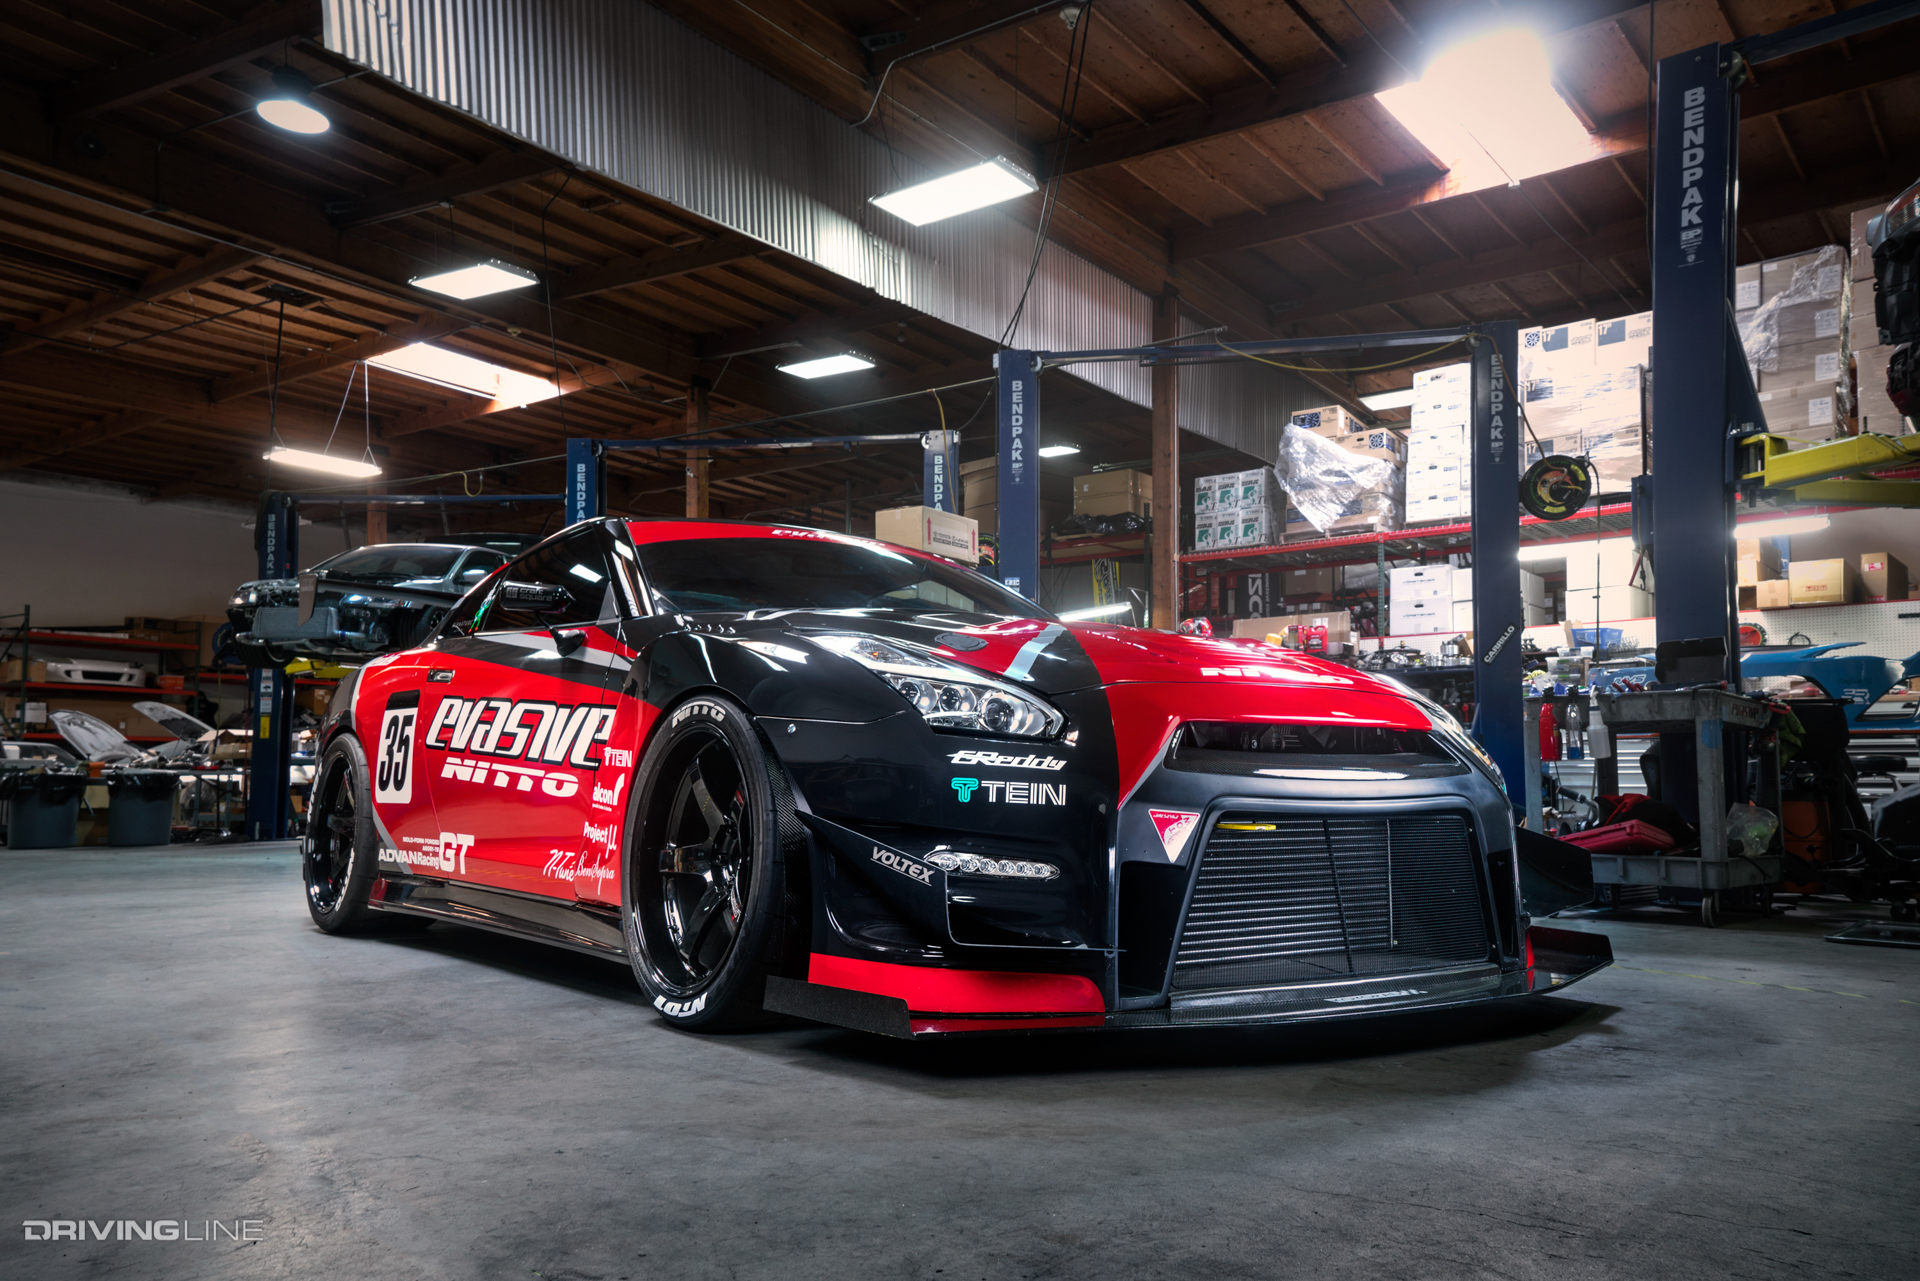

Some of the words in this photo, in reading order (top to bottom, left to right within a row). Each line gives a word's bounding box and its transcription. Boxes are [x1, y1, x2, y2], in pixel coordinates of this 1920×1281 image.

[1681, 86, 1706, 227] BENDPAK
[1490, 354, 1504, 440] BENDPAK
[1012, 380, 1023, 461] BENDPAK
[267, 514, 276, 569] BENDPAK
[1484, 625, 1515, 663] CARRILLO
[672, 700, 726, 729] NITTO
[378, 712, 414, 792] 35
[610, 749, 632, 768] TEIN
[947, 750, 1067, 771] GReddy
[440, 757, 579, 798] NITTO
[592, 782, 613, 805] alcon
[981, 780, 1067, 806] TEIN
[583, 821, 608, 844] Project
[378, 849, 417, 865] ADVAN
[417, 852, 440, 870] Racing
[439, 831, 475, 875] GT
[872, 846, 935, 883] VOLTEX
